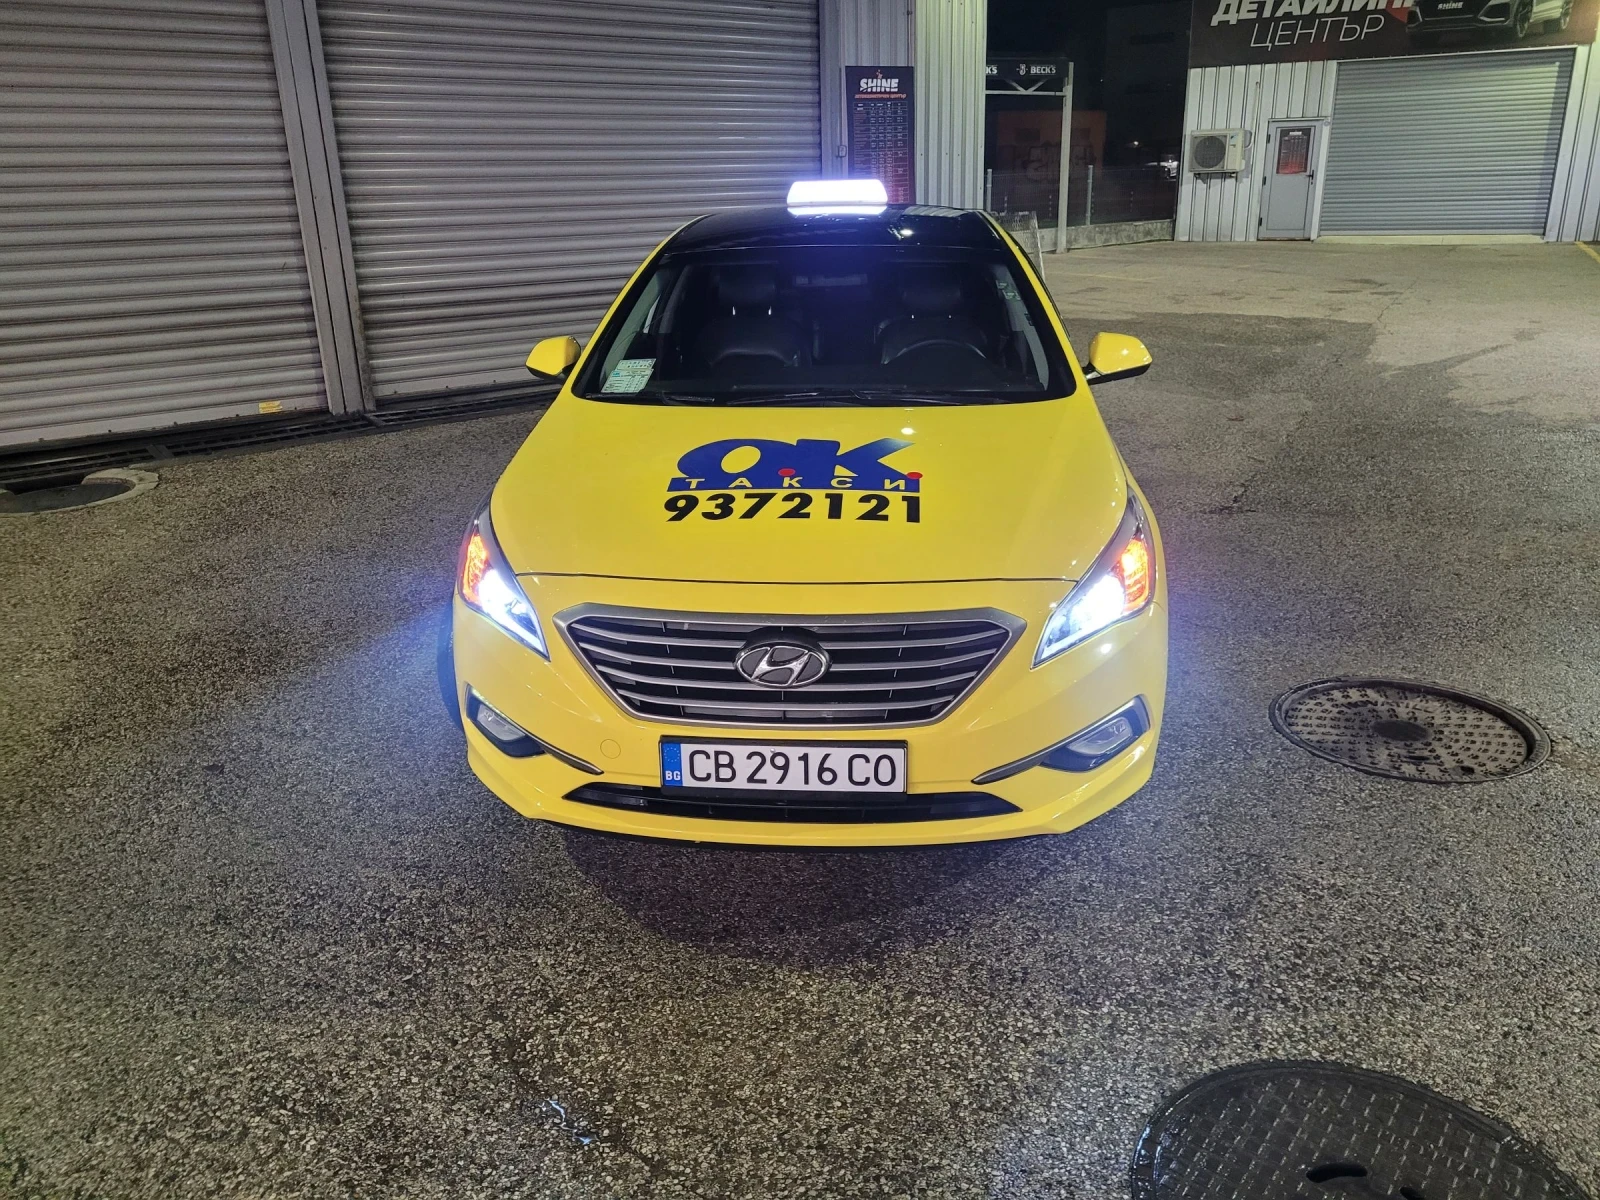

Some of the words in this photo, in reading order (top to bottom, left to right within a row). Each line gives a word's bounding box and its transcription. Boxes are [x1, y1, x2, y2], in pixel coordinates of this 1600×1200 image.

[1250, 14, 1385, 51] ЦЕНТЪР
[859, 78, 899, 92] SHINE
[685, 476, 906, 490] ТАКСИ
[664, 492, 921, 523] 9372121
[665, 770, 681, 781] BG
[689, 749, 737, 783] CB
[746, 751, 838, 786] 2916
